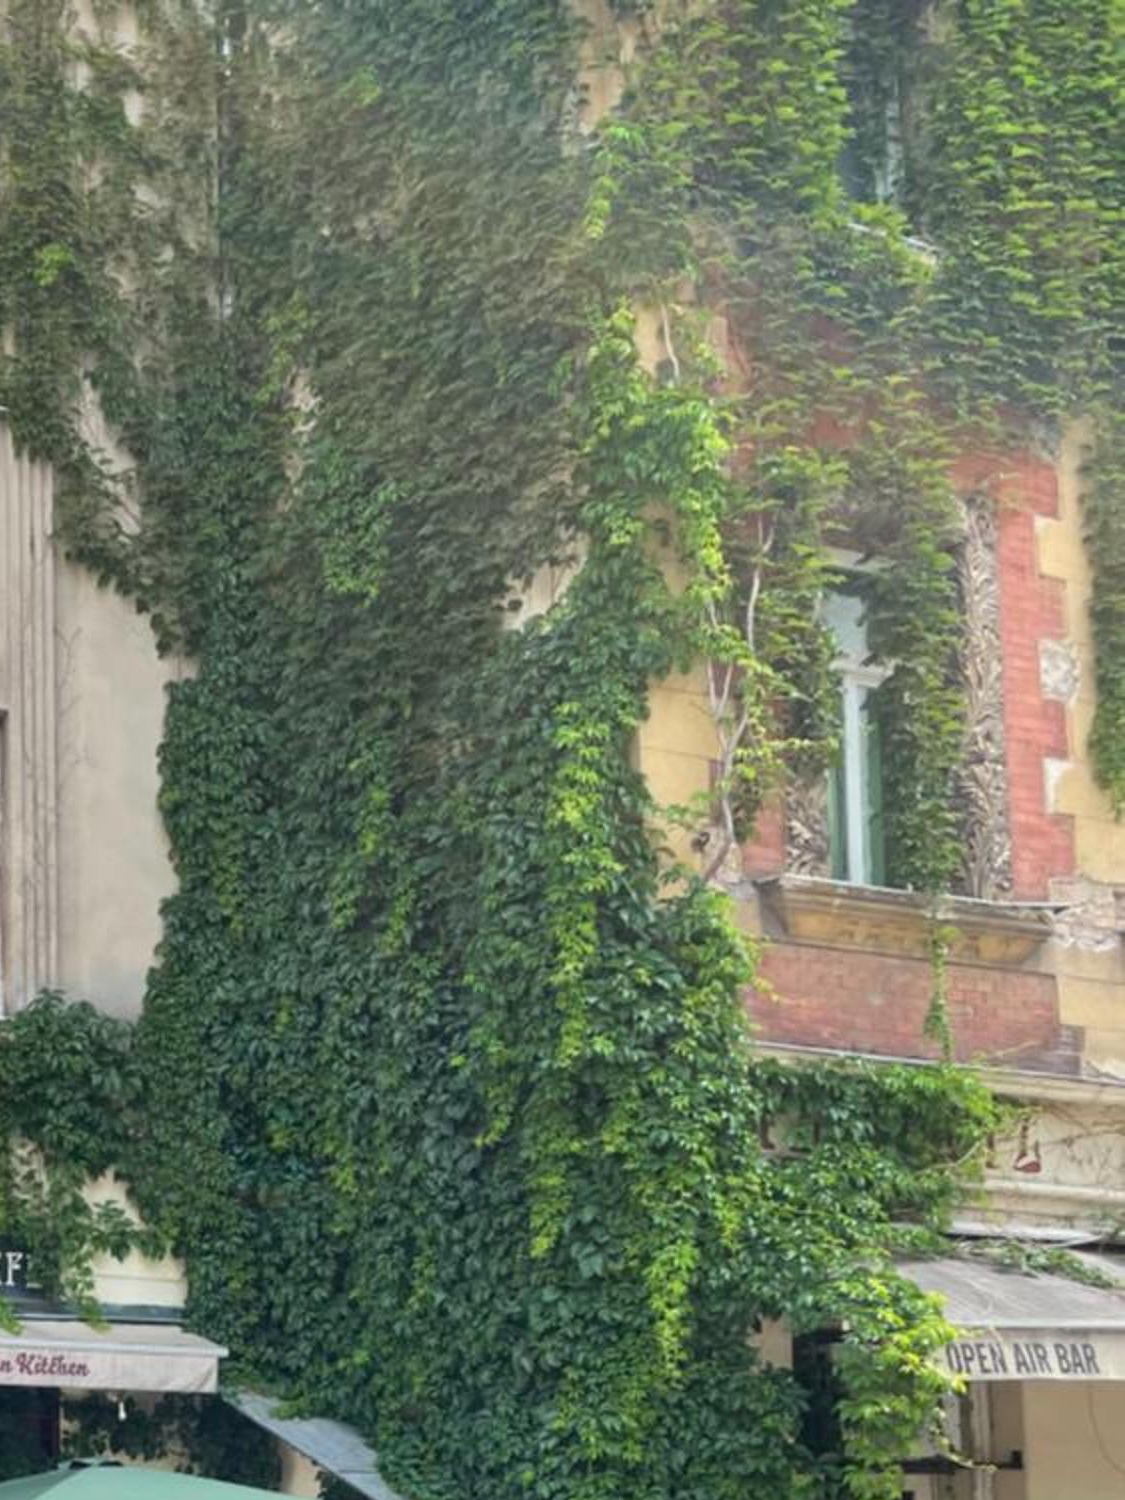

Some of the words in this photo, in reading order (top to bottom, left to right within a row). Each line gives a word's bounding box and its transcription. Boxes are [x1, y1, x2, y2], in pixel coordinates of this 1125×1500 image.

[944, 1343, 1008, 1375] OPEN
[1012, 1344, 1052, 1374] AIR
[1052, 1344, 1100, 1375] BAR
